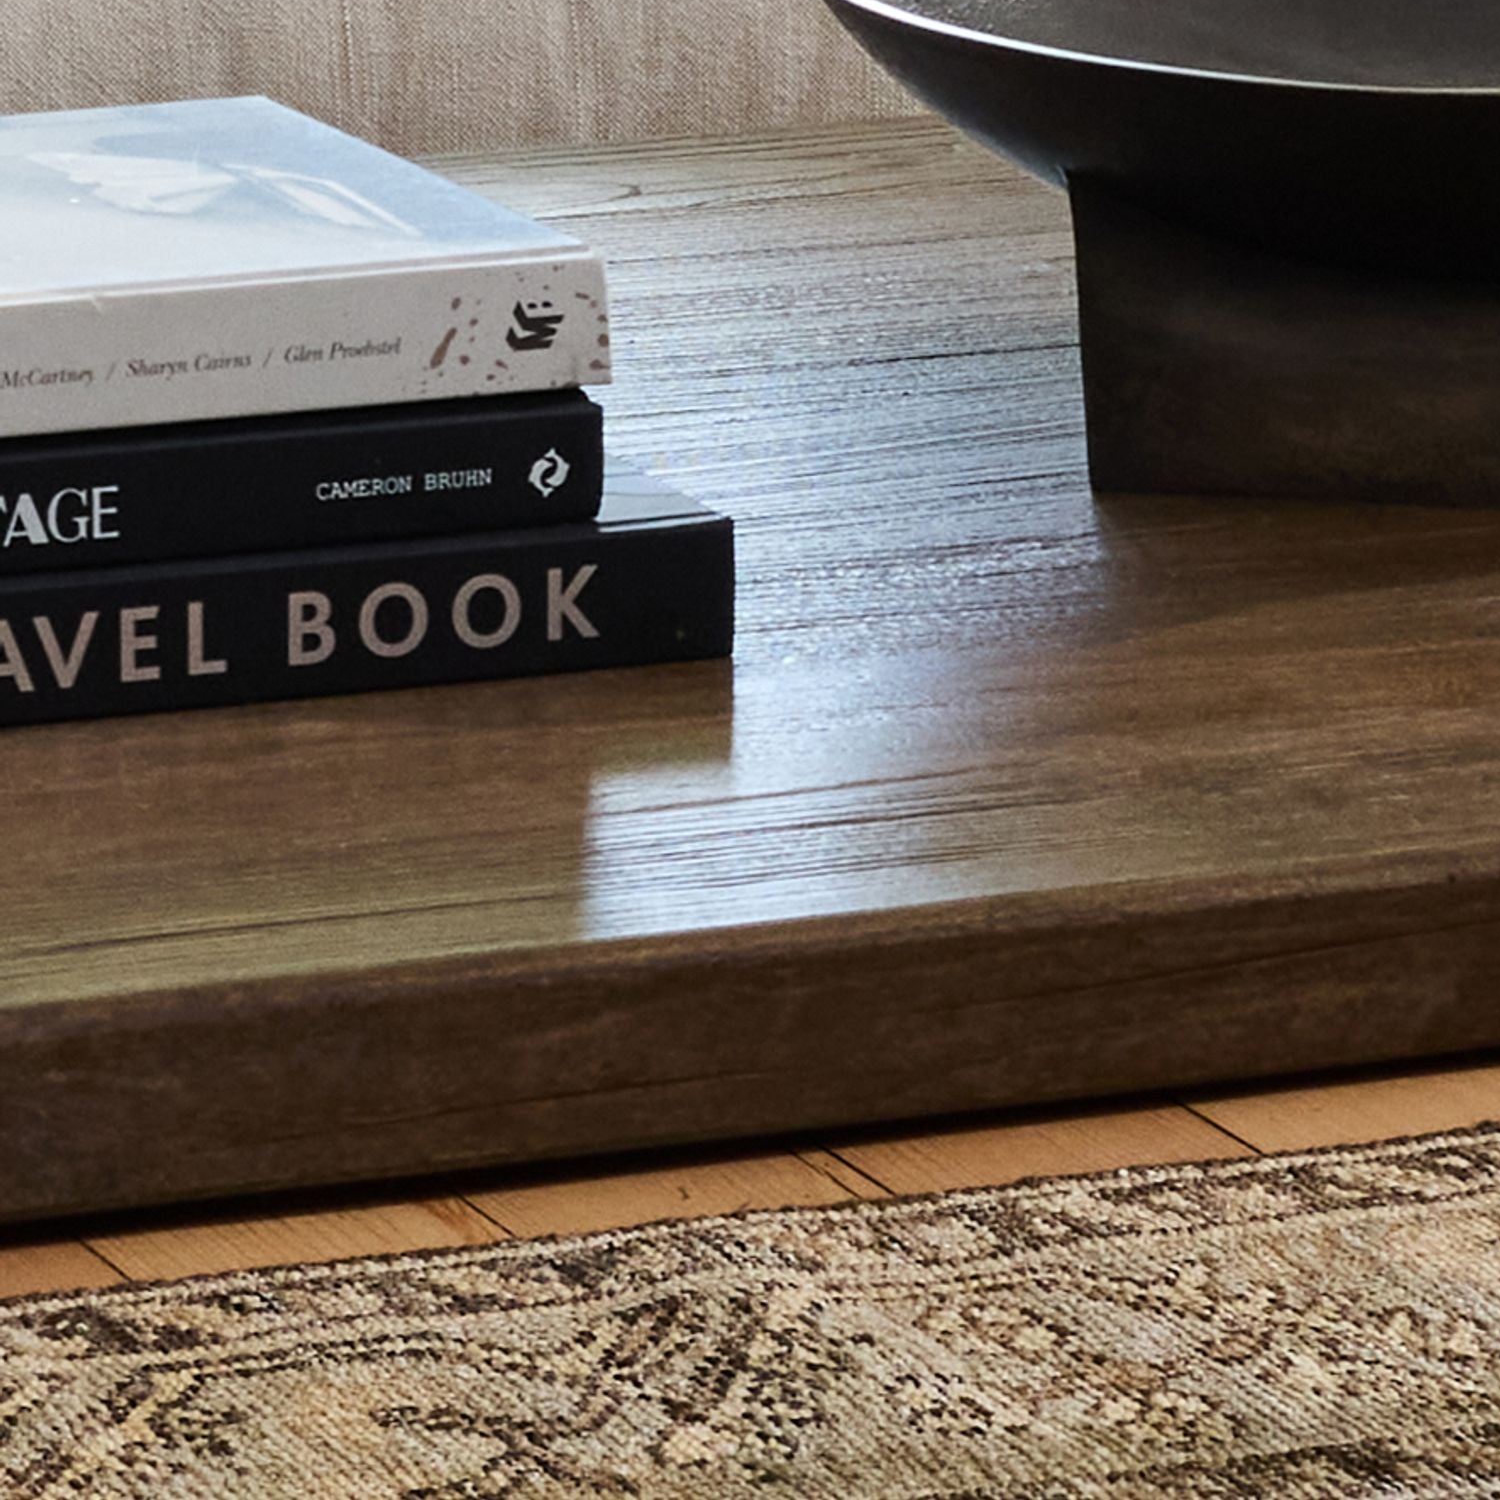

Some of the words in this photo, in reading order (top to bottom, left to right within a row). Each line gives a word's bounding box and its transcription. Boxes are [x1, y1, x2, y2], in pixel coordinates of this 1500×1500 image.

[126, 357, 188, 381] Sharyn
[195, 352, 252, 371] Cairns
[284, 344, 323, 364] Glen
[315, 475, 413, 501] CAMERON
[423, 467, 493, 491] BRUHN
[0, 485, 120, 548] AGE
[287, 564, 600, 666] BOOK
